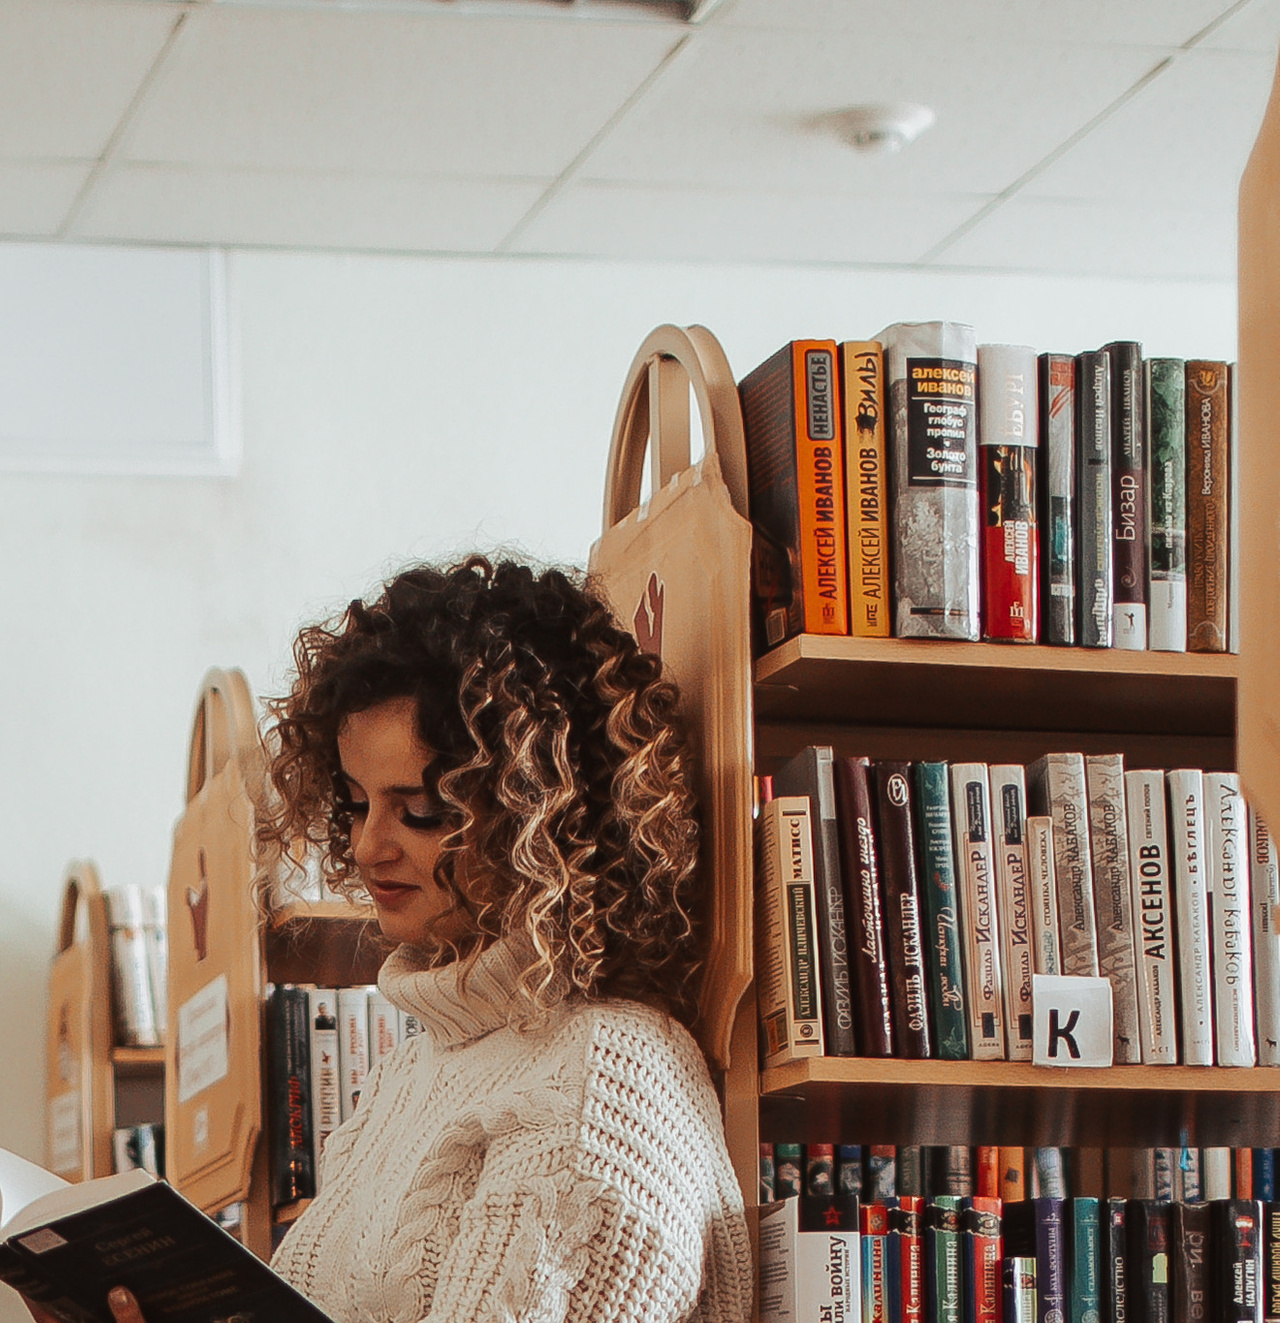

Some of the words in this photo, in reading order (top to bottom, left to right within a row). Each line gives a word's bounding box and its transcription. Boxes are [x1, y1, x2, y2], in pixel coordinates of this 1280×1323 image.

[810, 355, 829, 435] НЕНАСТЬЕ
[912, 366, 975, 381] алексей
[917, 380, 972, 396] иванов
[923, 402, 967, 418] Географ
[926, 427, 965, 440] пропил
[928, 416, 964, 429] глобус
[1201, 397, 1213, 448] ИВАНОВА
[926, 448, 966, 462] Золото
[931, 460, 963, 475] бунта
[1201, 449, 1213, 496] Вероника
[813, 446, 833, 522] ИВАНОВ
[859, 447, 879, 522] ИВАНОВ
[1116, 475, 1140, 541] Бизар
[813, 531, 837, 600] АЛЕКСЕЙ
[858, 530, 881, 599] АЛЕКСЕЙ
[1004, 520, 1015, 562] АЛЕКСЕЙ
[1015, 520, 1029, 575] ИВАНОВ
[791, 818, 804, 880] МАТИСС
[856, 817, 871, 865] гнездо
[1040, 830, 1049, 880] ЧЕЛОВЕКА
[1064, 803, 1081, 864] КАБАКОВ
[794, 887, 808, 955] ИЛИЧЕВСКИЙ
[861, 868, 877, 963] Ласточкино
[1043, 881, 1052, 926] СТОЯНКА
[1140, 844, 1165, 960] АКСЕНОВ
[1191, 891, 1200, 942] КАБАКОВ
[900, 893, 919, 966] ИСКАНДЕР
[797, 958, 811, 1017] АЛЕКСАНДР
[906, 974, 924, 1031] ФАЗИЛЬ
[1152, 965, 1160, 996] КАБАКОВ
[1194, 947, 1204, 1012] АЛЕКСАНДР
[1048, 1009, 1081, 1059] К
[1154, 997, 1162, 1037] АЛЕКСАНДР
[825, 1235, 847, 1299] войну
[943, 1240, 958, 1311] Калинина
[981, 1244, 996, 1314] Калинина
[1233, 1262, 1243, 1304] Алексей
[1245, 1259, 1255, 1306] КАЛУГИН
